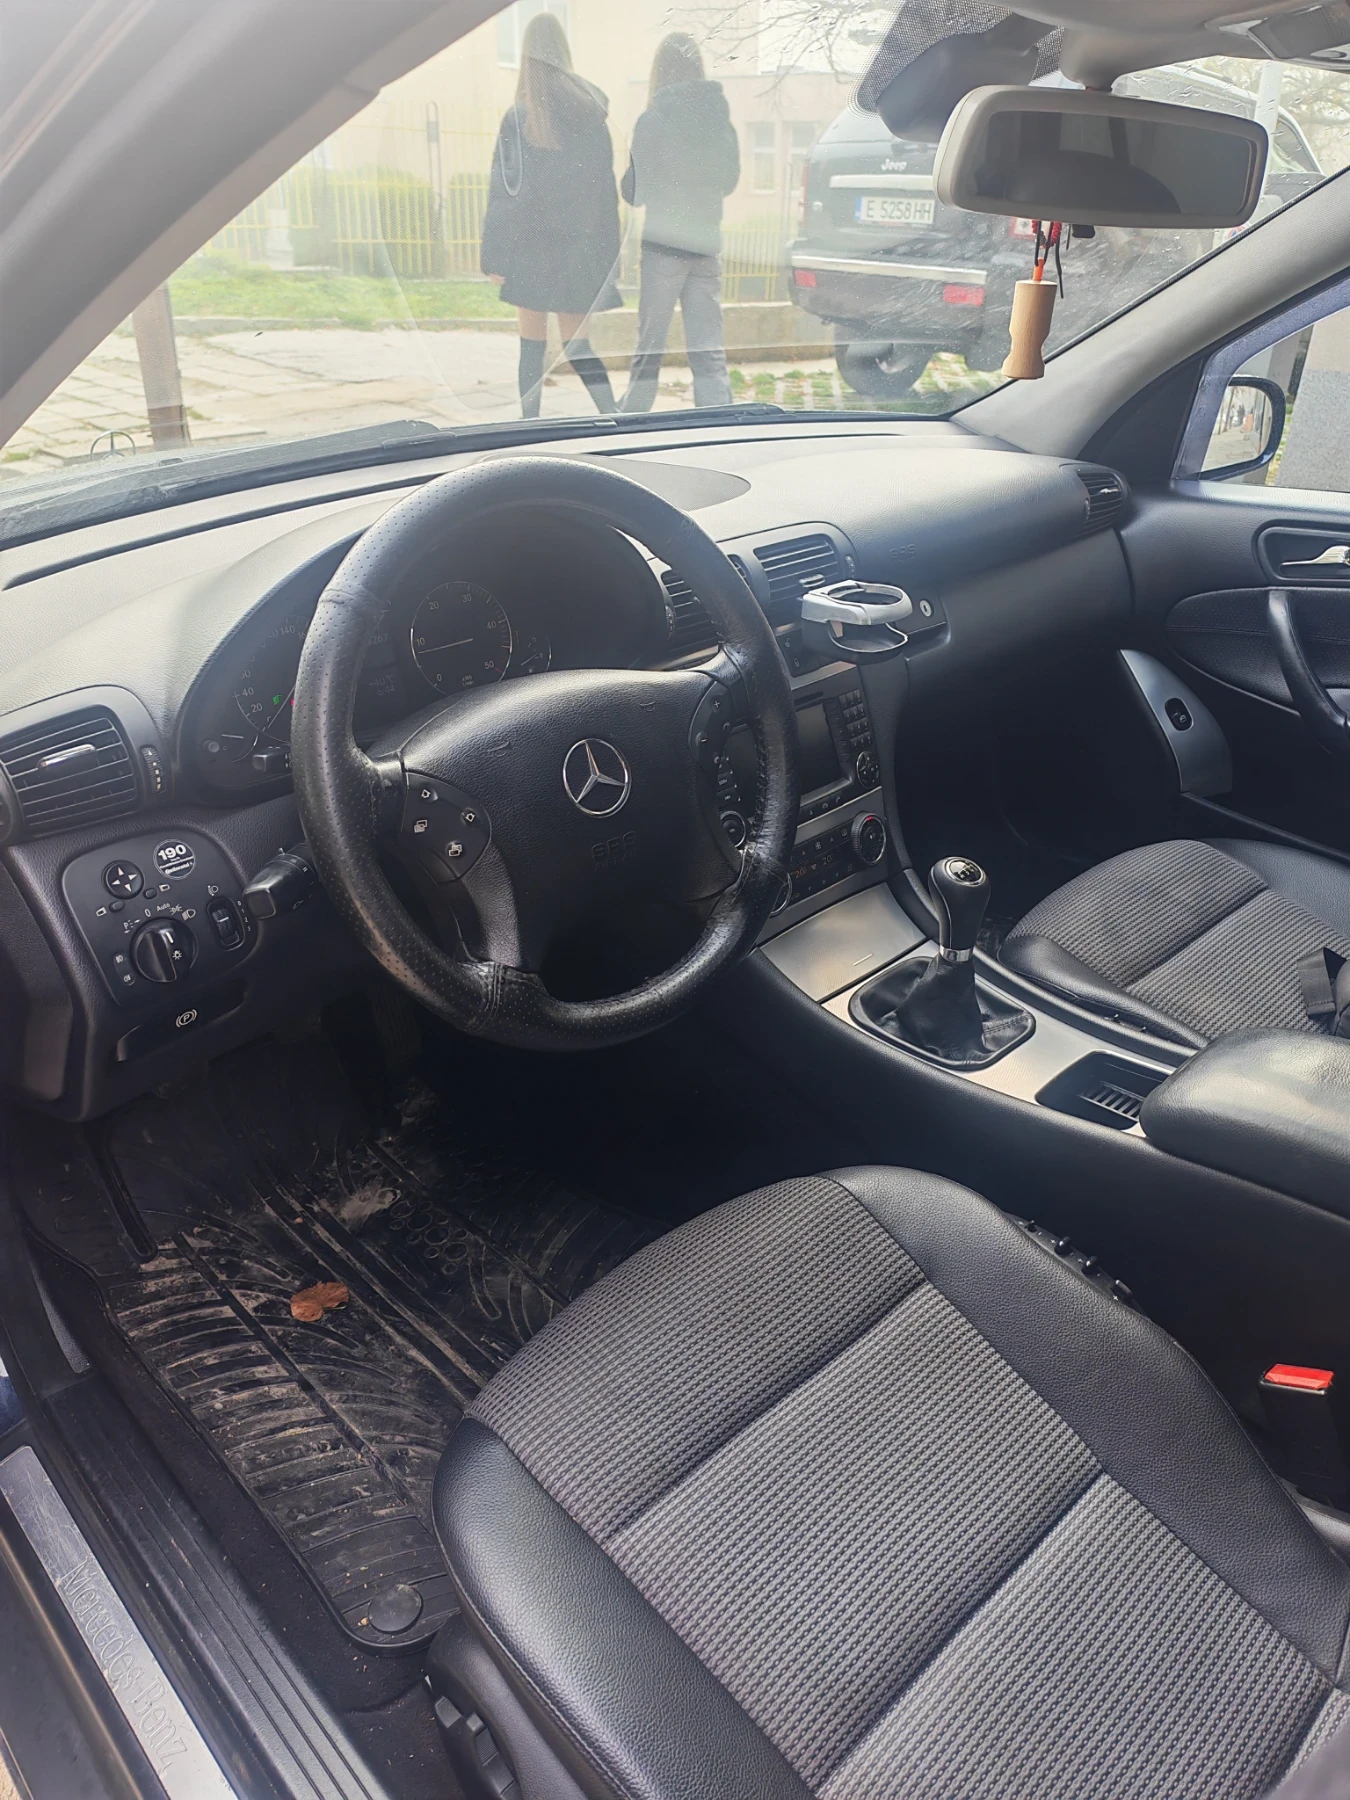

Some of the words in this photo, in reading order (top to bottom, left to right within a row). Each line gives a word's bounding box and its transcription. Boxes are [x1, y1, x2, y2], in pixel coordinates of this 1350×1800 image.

[881, 158, 907, 172] Jeep
[866, 200, 875, 218] E
[462, 593, 472, 603] 30
[429, 601, 440, 610] 20
[487, 620, 497, 630] 40
[281, 625, 296, 636] 140
[416, 637, 426, 646] 10
[484, 660, 495, 670] 50
[436, 673, 442, 682] 0
[242, 687, 254, 696] 40
[251, 703, 263, 713] 20
[158, 845, 186, 860] 190
[157, 903, 170, 911] Auto
[61, 1556, 187, 1774] Mercedes-Benz
